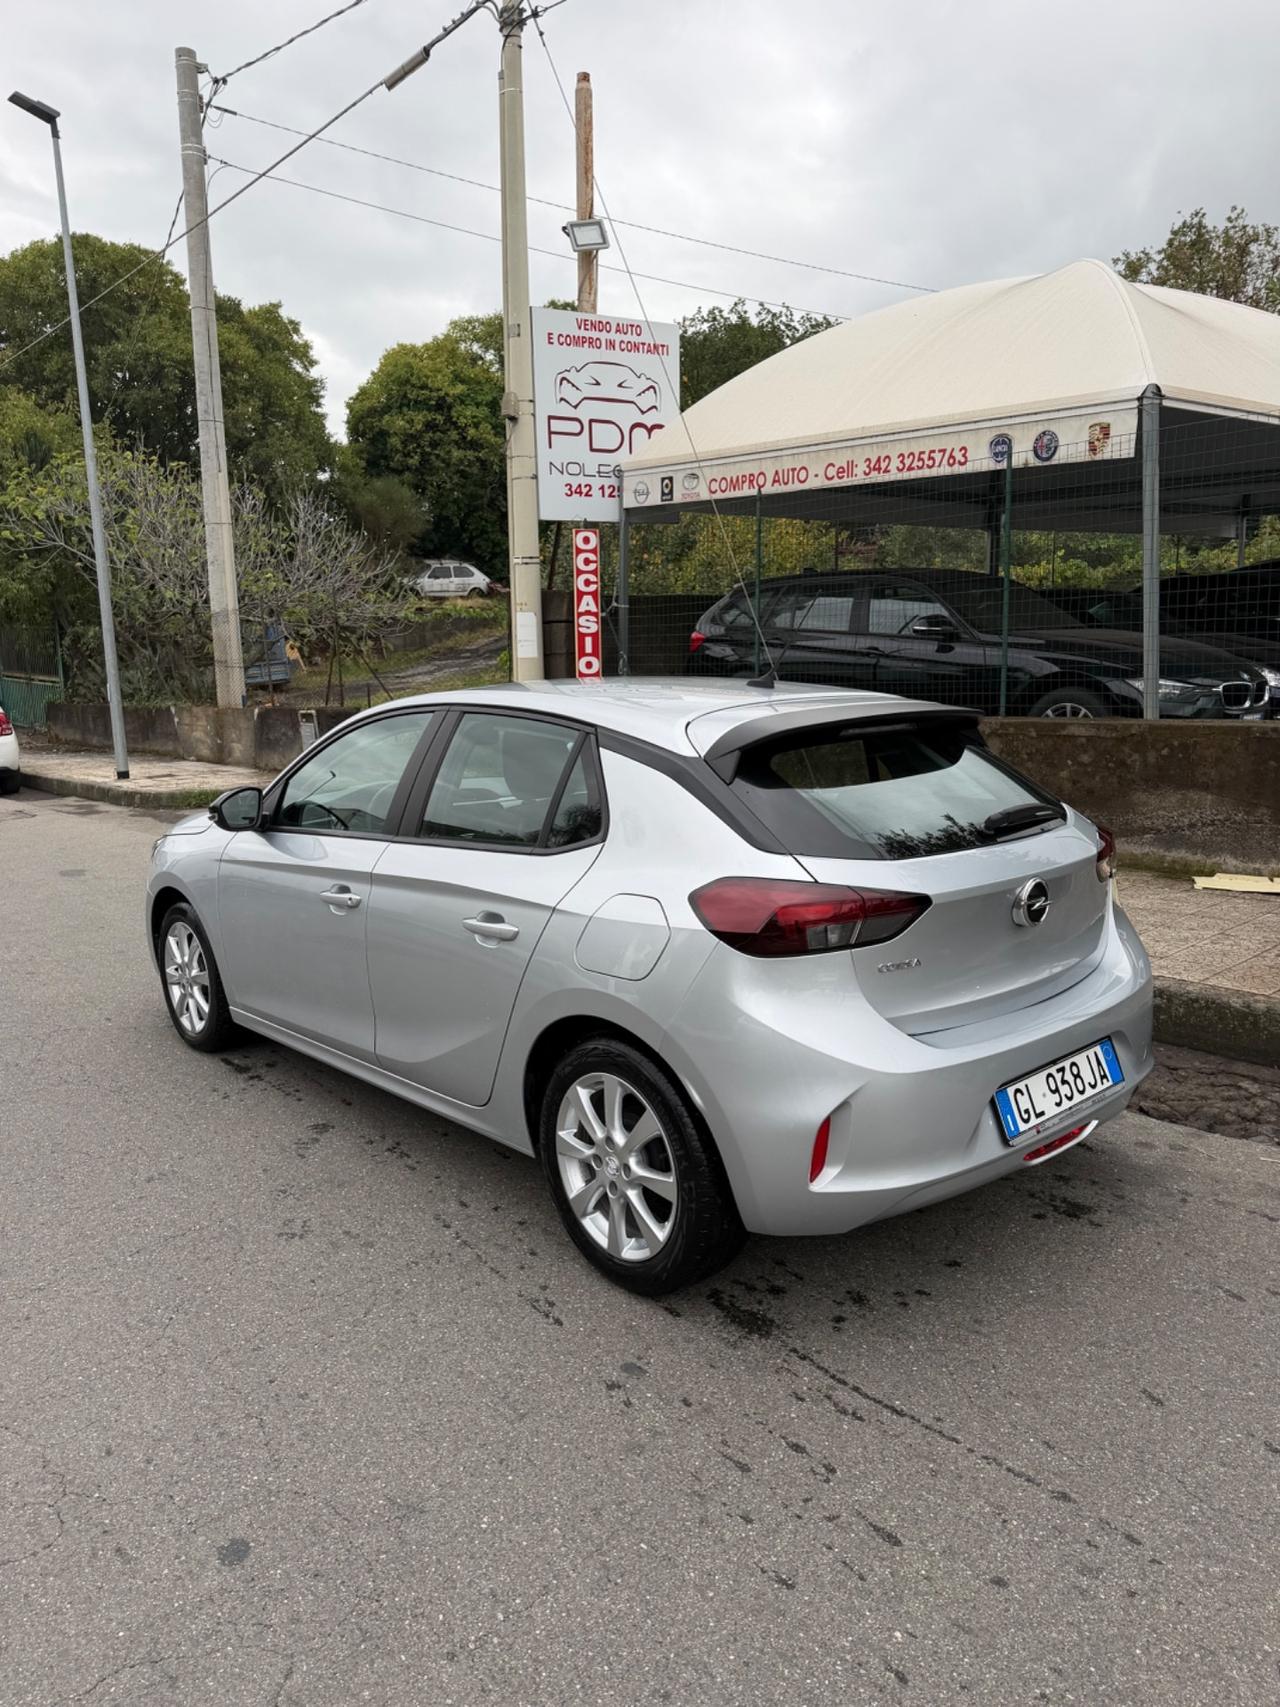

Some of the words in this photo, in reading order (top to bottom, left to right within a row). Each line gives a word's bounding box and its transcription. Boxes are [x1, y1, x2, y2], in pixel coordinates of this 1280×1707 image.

[576, 317, 612, 333] VENDO
[615, 322, 642, 337] AUTO
[547, 332, 554, 345] E
[557, 334, 601, 349] COMPRO
[605, 340, 616, 351] IN
[619, 340, 669, 356] CONTANTI
[708, 471, 767, 495] COMPRO
[771, 466, 809, 488] AUTO
[824, 460, 858, 481] Cell:
[863, 455, 891, 476] 342
[896, 446, 968, 473] 3255763
[564, 483, 593, 497] 342
[576, 531, 600, 674] OCCASIO
[1013, 1084, 1046, 1124] GL
